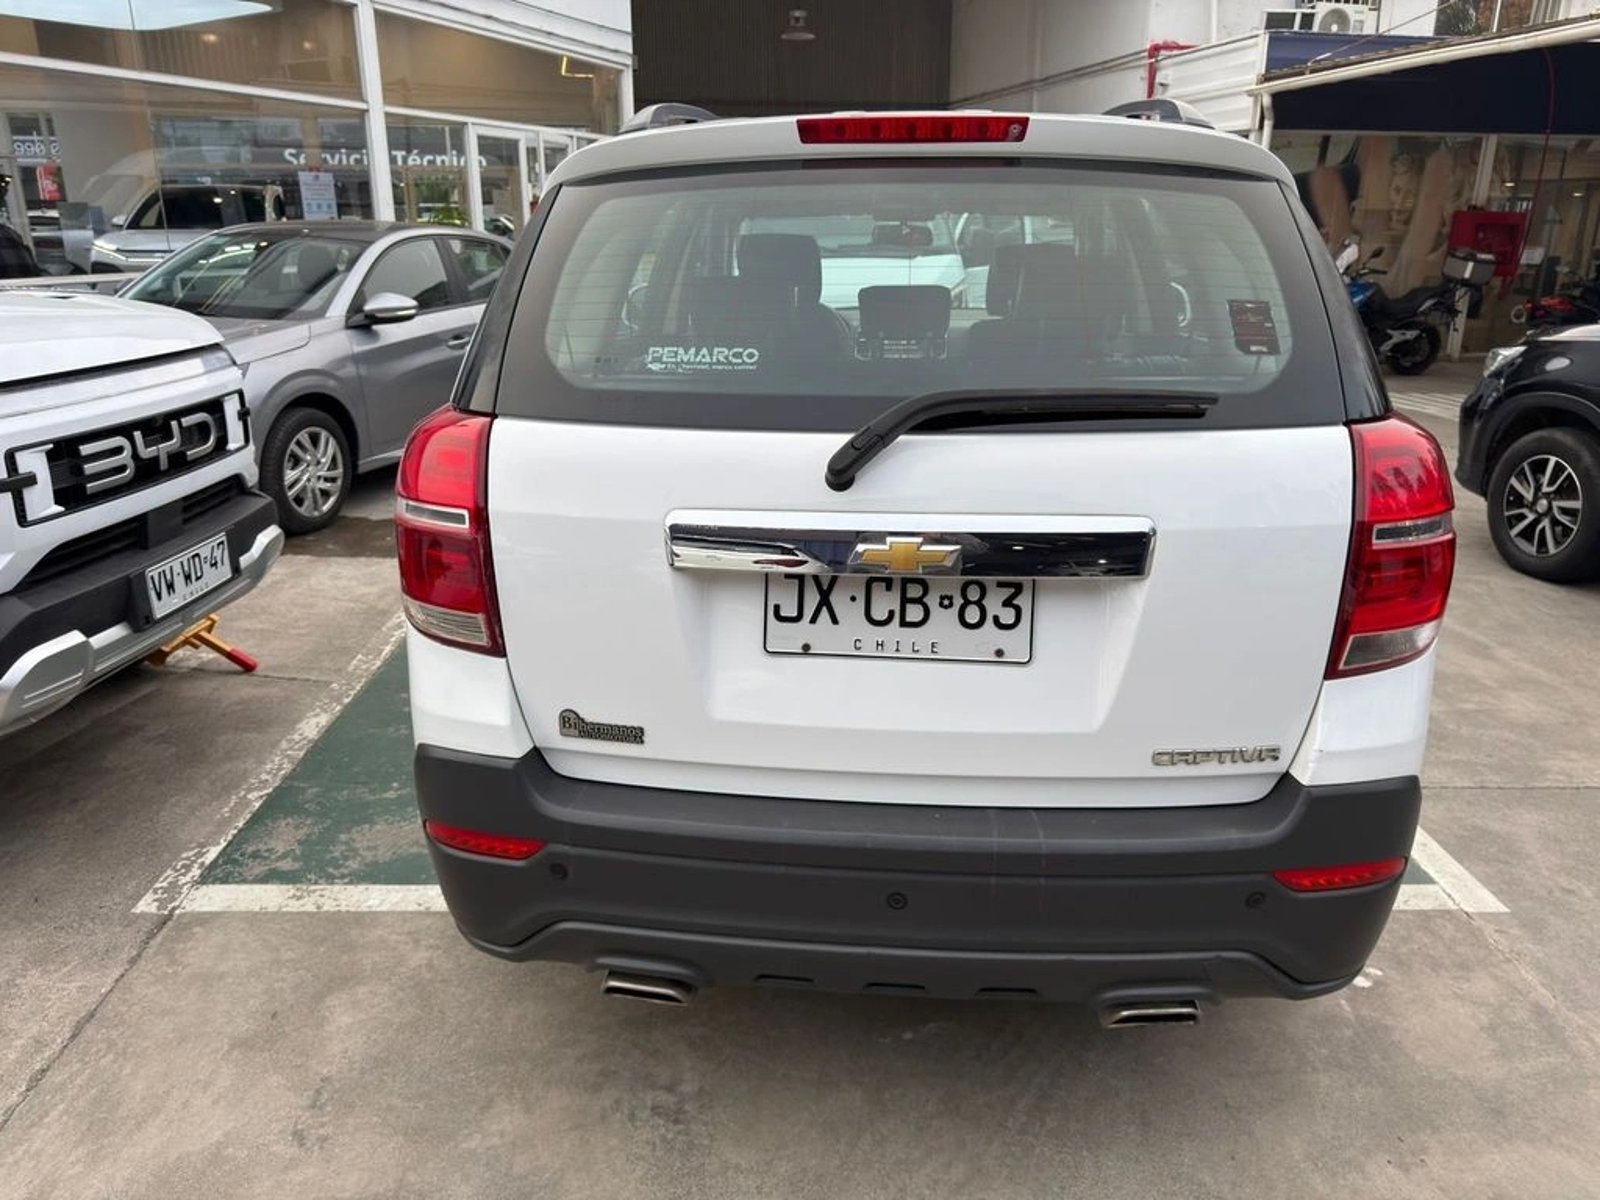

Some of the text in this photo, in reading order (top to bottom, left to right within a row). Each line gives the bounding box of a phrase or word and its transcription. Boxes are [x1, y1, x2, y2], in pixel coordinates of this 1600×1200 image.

[646, 346, 760, 364] PEMARCO
[79, 411, 218, 495] BYD
[853, 638, 939, 654] CHILE
[1151, 745, 1282, 766] CAPTIVA
